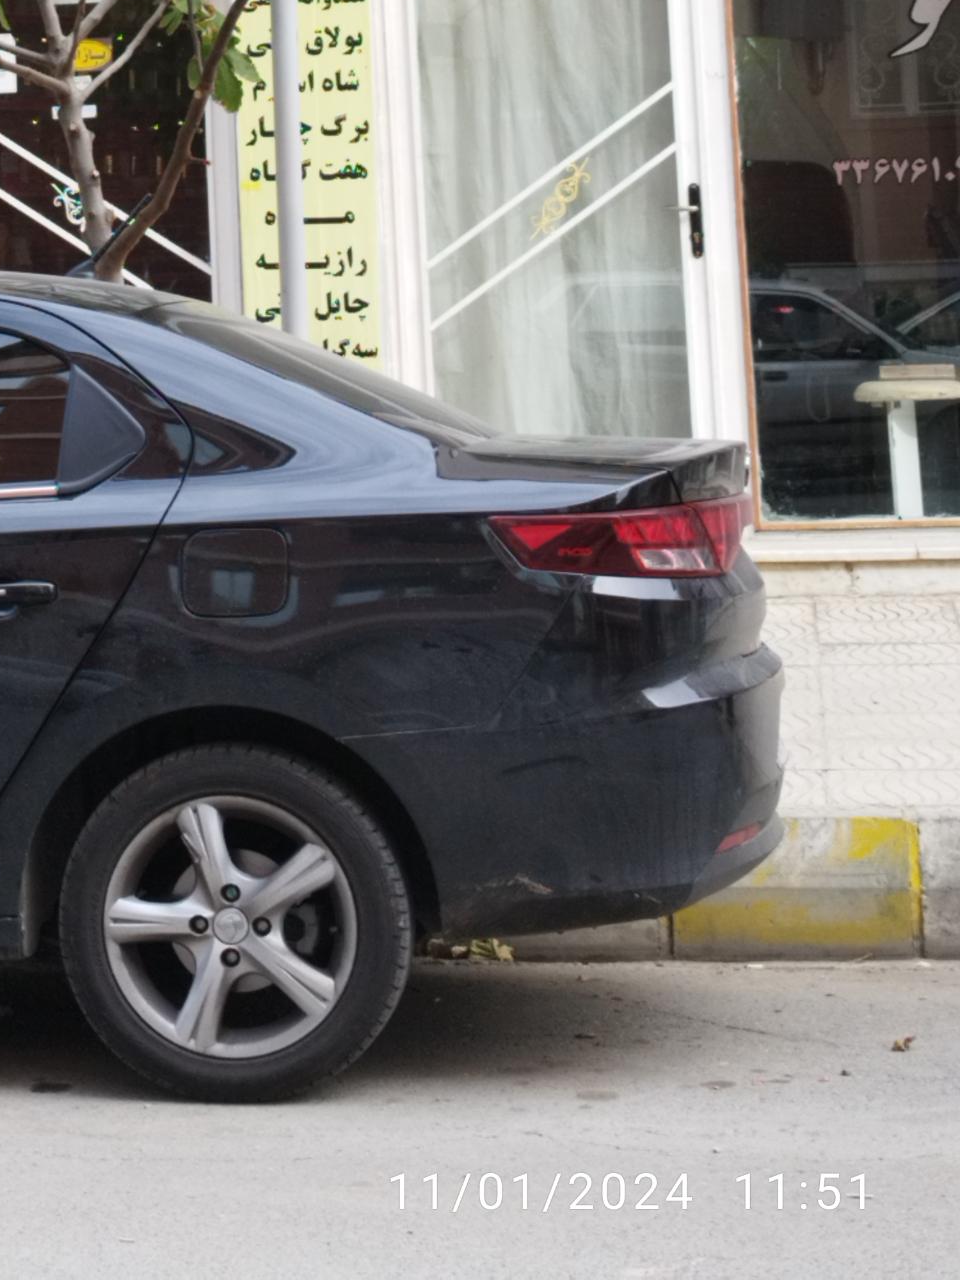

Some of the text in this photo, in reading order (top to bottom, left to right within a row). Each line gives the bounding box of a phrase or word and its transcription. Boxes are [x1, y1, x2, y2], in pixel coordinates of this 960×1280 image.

[322, 69, 360, 93] شاه
[321, 114, 370, 144] برگ
[319, 159, 368, 181] هفت
